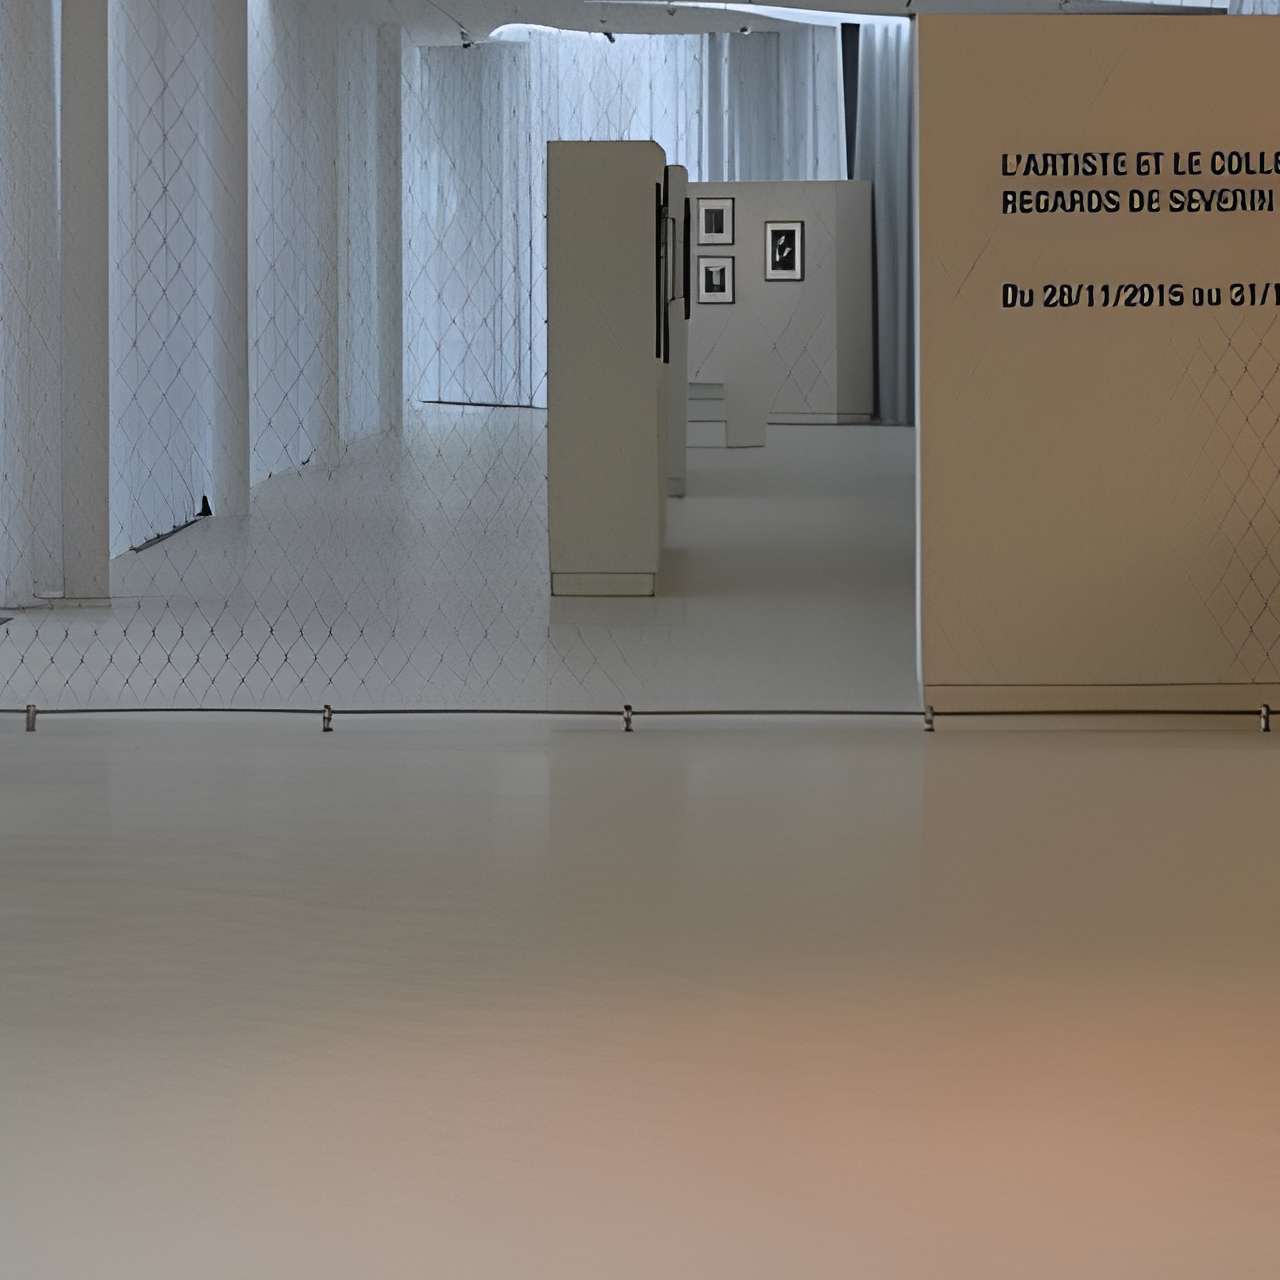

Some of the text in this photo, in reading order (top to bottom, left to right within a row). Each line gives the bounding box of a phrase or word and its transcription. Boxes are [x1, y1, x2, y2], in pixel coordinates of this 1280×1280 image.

[1001, 151, 1128, 177] L'ARTISTE
[1136, 151, 1165, 177] ET
[1173, 151, 1203, 176] LE
[1002, 189, 1121, 215] REGARDS
[1128, 188, 1161, 213] DE
[1002, 283, 1034, 308] Du
